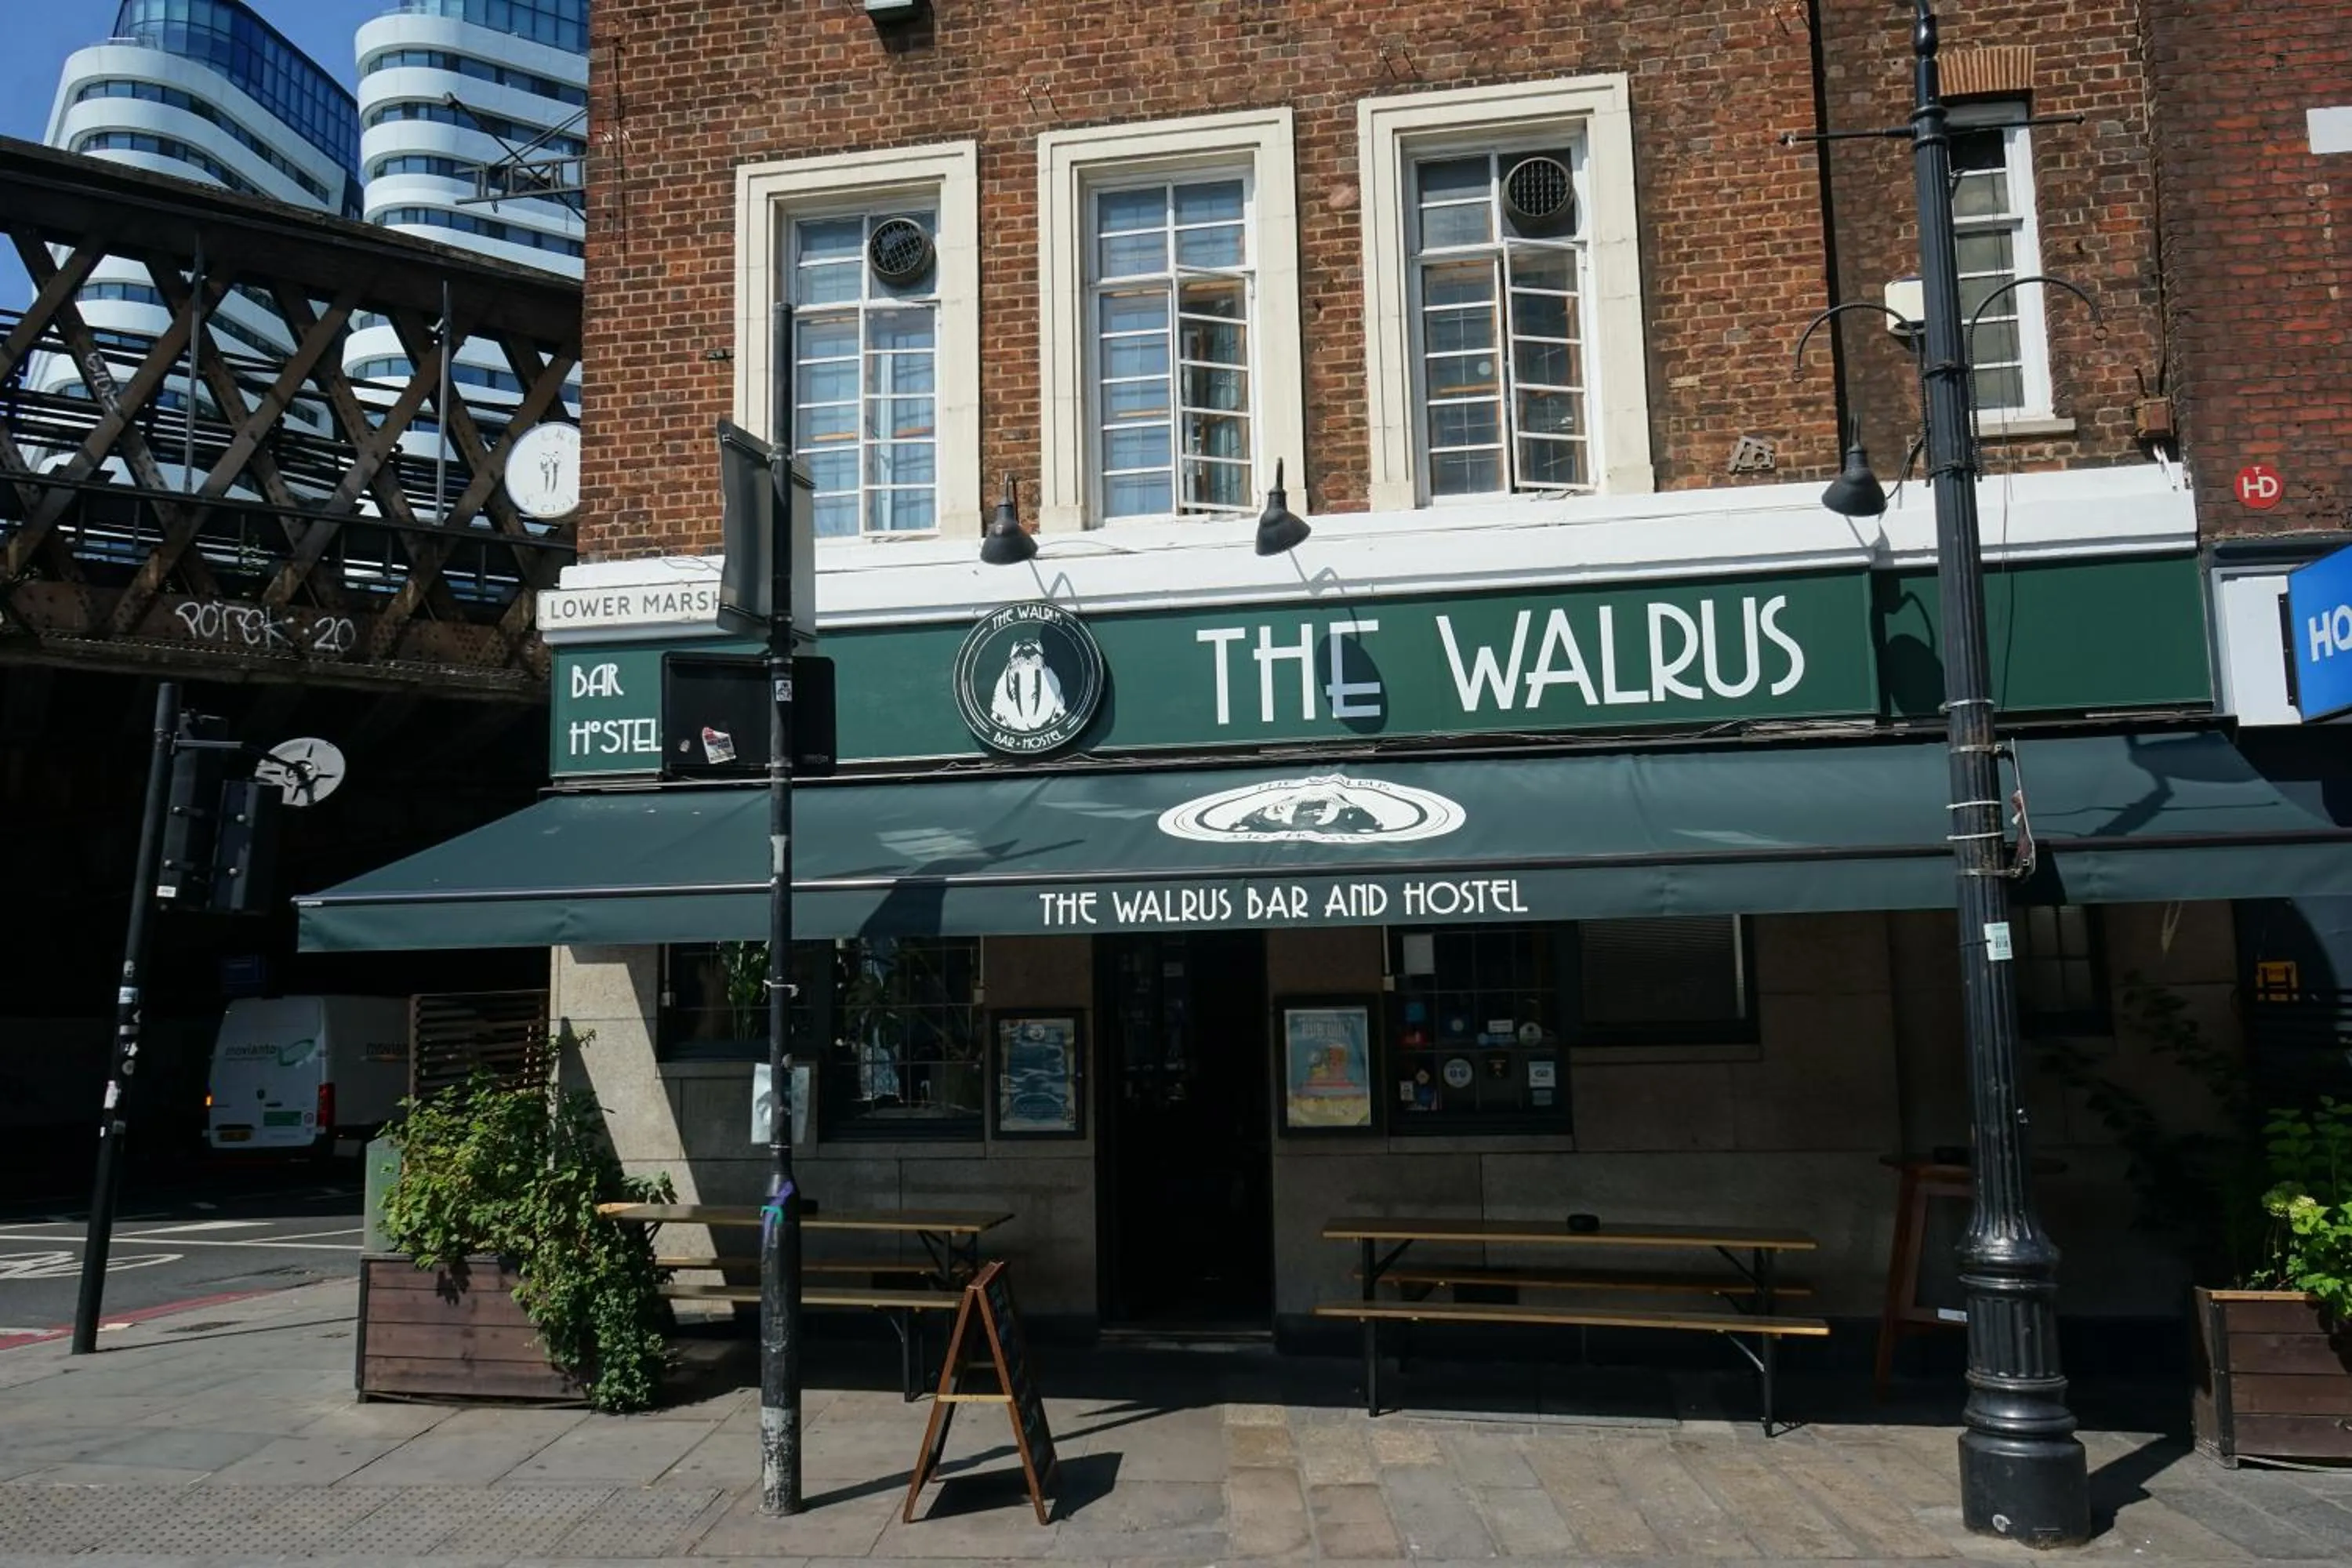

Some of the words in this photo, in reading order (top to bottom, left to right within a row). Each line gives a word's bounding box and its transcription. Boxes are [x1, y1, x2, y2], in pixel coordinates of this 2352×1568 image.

[550, 595, 630, 619] LOWER
[992, 608, 1014, 630] THE
[1017, 604, 1063, 626] WALRUS
[1196, 618, 1381, 725] THE
[1436, 595, 1806, 712] WALRUS
[572, 662, 624, 699] BAR
[569, 717, 662, 755] HOSTEL
[1039, 891, 1098, 926] THE
[1112, 887, 1232, 924] WALRUS
[1247, 885, 1309, 920] BAR
[1324, 883, 1388, 918] AND
[1403, 878, 1529, 916] HOSTEL
